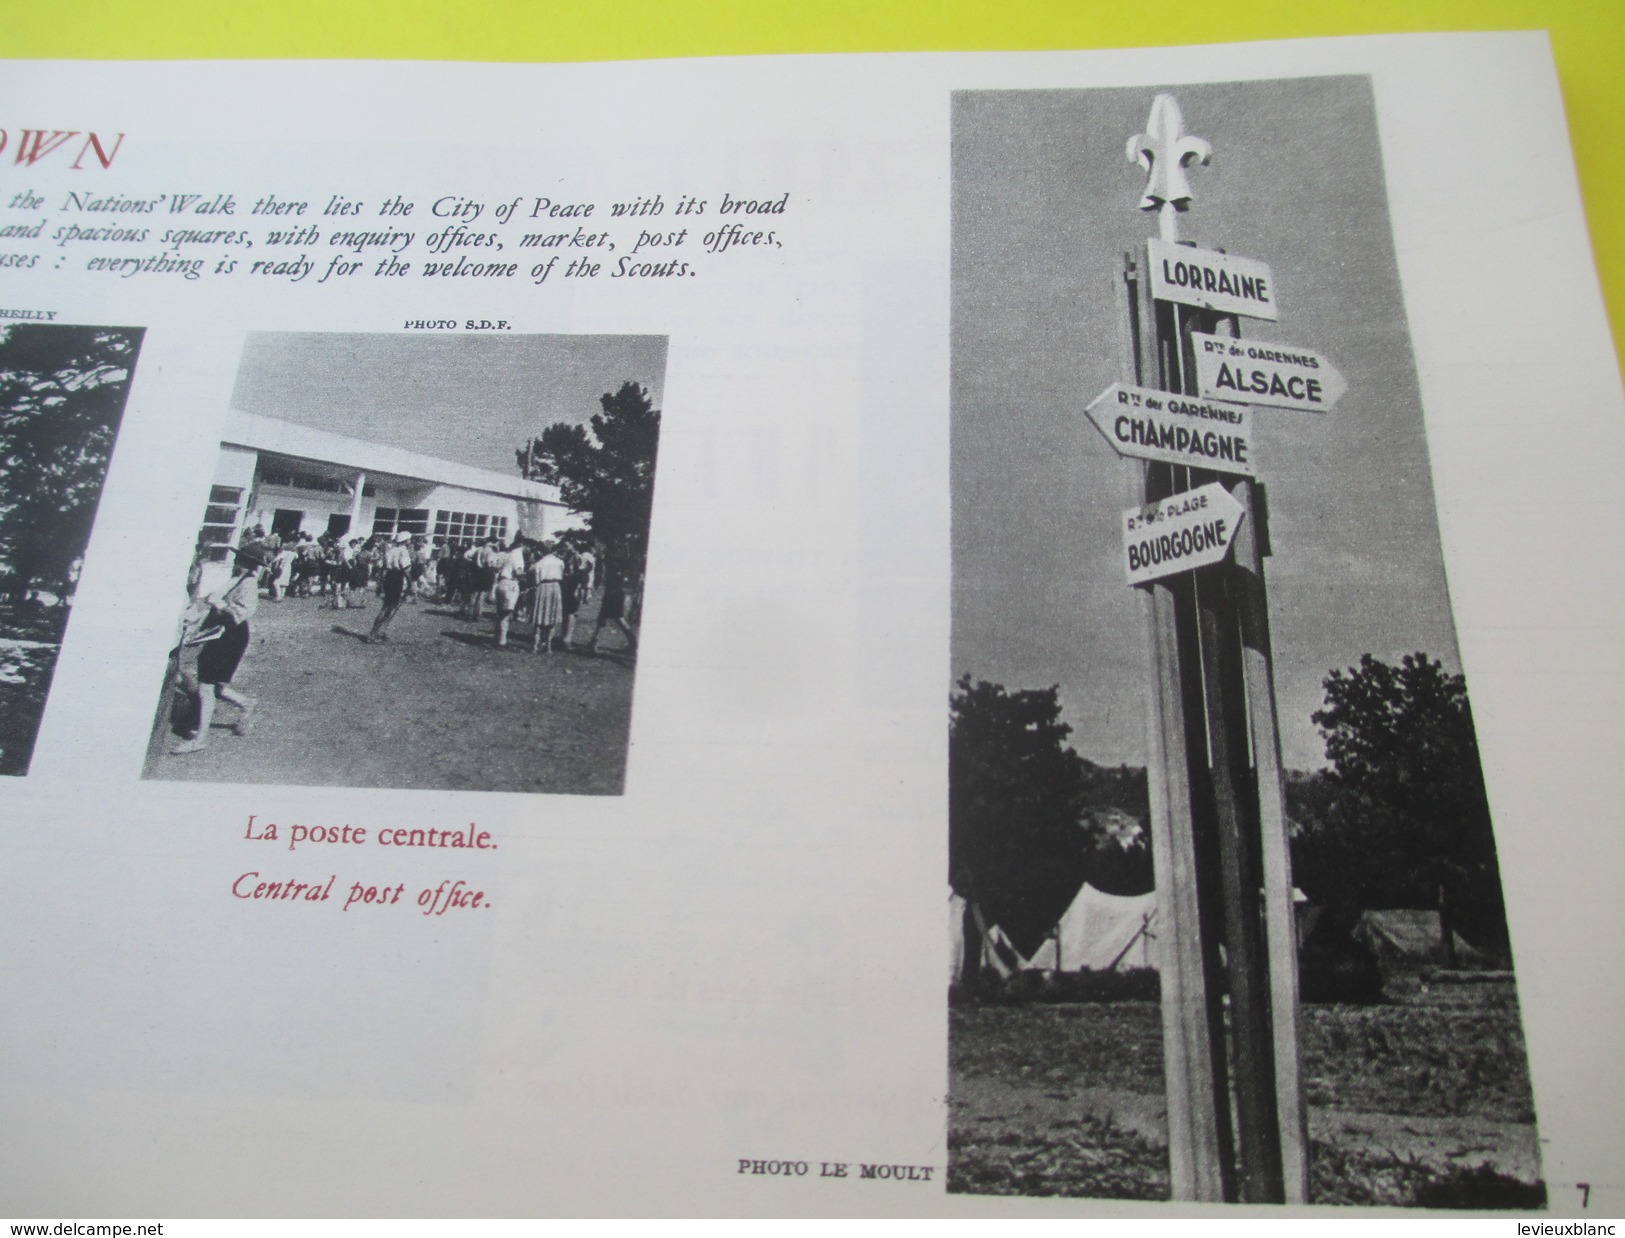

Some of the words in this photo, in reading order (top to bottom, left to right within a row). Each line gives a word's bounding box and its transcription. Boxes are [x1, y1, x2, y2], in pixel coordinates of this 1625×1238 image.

[6, 187, 46, 212] the
[250, 193, 310, 218] there
[322, 193, 366, 218] lies
[377, 193, 416, 218] the
[430, 194, 486, 224] City
[494, 195, 524, 225] of
[528, 195, 597, 219] Peace
[609, 193, 666, 218] with
[674, 192, 709, 217] its
[718, 191, 791, 216] broad
[0, 218, 48, 240] and
[52, 222, 152, 248] spacious
[160, 228, 255, 252] squares,
[265, 223, 322, 247] with
[328, 228, 417, 254] enquiry
[424, 224, 506, 256] offices,
[518, 226, 618, 253] market,
[630, 226, 690, 255] post
[701, 222, 785, 255] offices,
[86, 252, 204, 281] everything
[213, 254, 239, 276] is
[249, 256, 317, 283] ready
[317, 254, 366, 283] for
[373, 256, 413, 279] the
[422, 254, 521, 280] welcome
[530, 254, 556, 286] of
[563, 254, 603, 280] the
[609, 254, 699, 280] Scouts.
[1162, 257, 1270, 304] LORRAINE
[403, 319, 458, 331] PHOTO
[464, 319, 512, 331] S.D.F.
[1246, 346, 1320, 370] GARENNES
[1214, 360, 1324, 404] ALSACE
[1113, 414, 1248, 464] CHAMPAGNE
[1166, 494, 1209, 517] PLAGE
[1127, 518, 1228, 572] BOURGOGNE
[242, 813, 280, 842] La
[286, 820, 368, 852] poste
[376, 820, 500, 850] centrale.
[230, 870, 338, 902] Central
[341, 880, 406, 913] post
[416, 878, 493, 917] office.
[737, 1158, 810, 1177] PHOTO
[819, 1162, 849, 1178] LE
[858, 1163, 935, 1182] MOULT
[1575, 1182, 1591, 1209] 7
